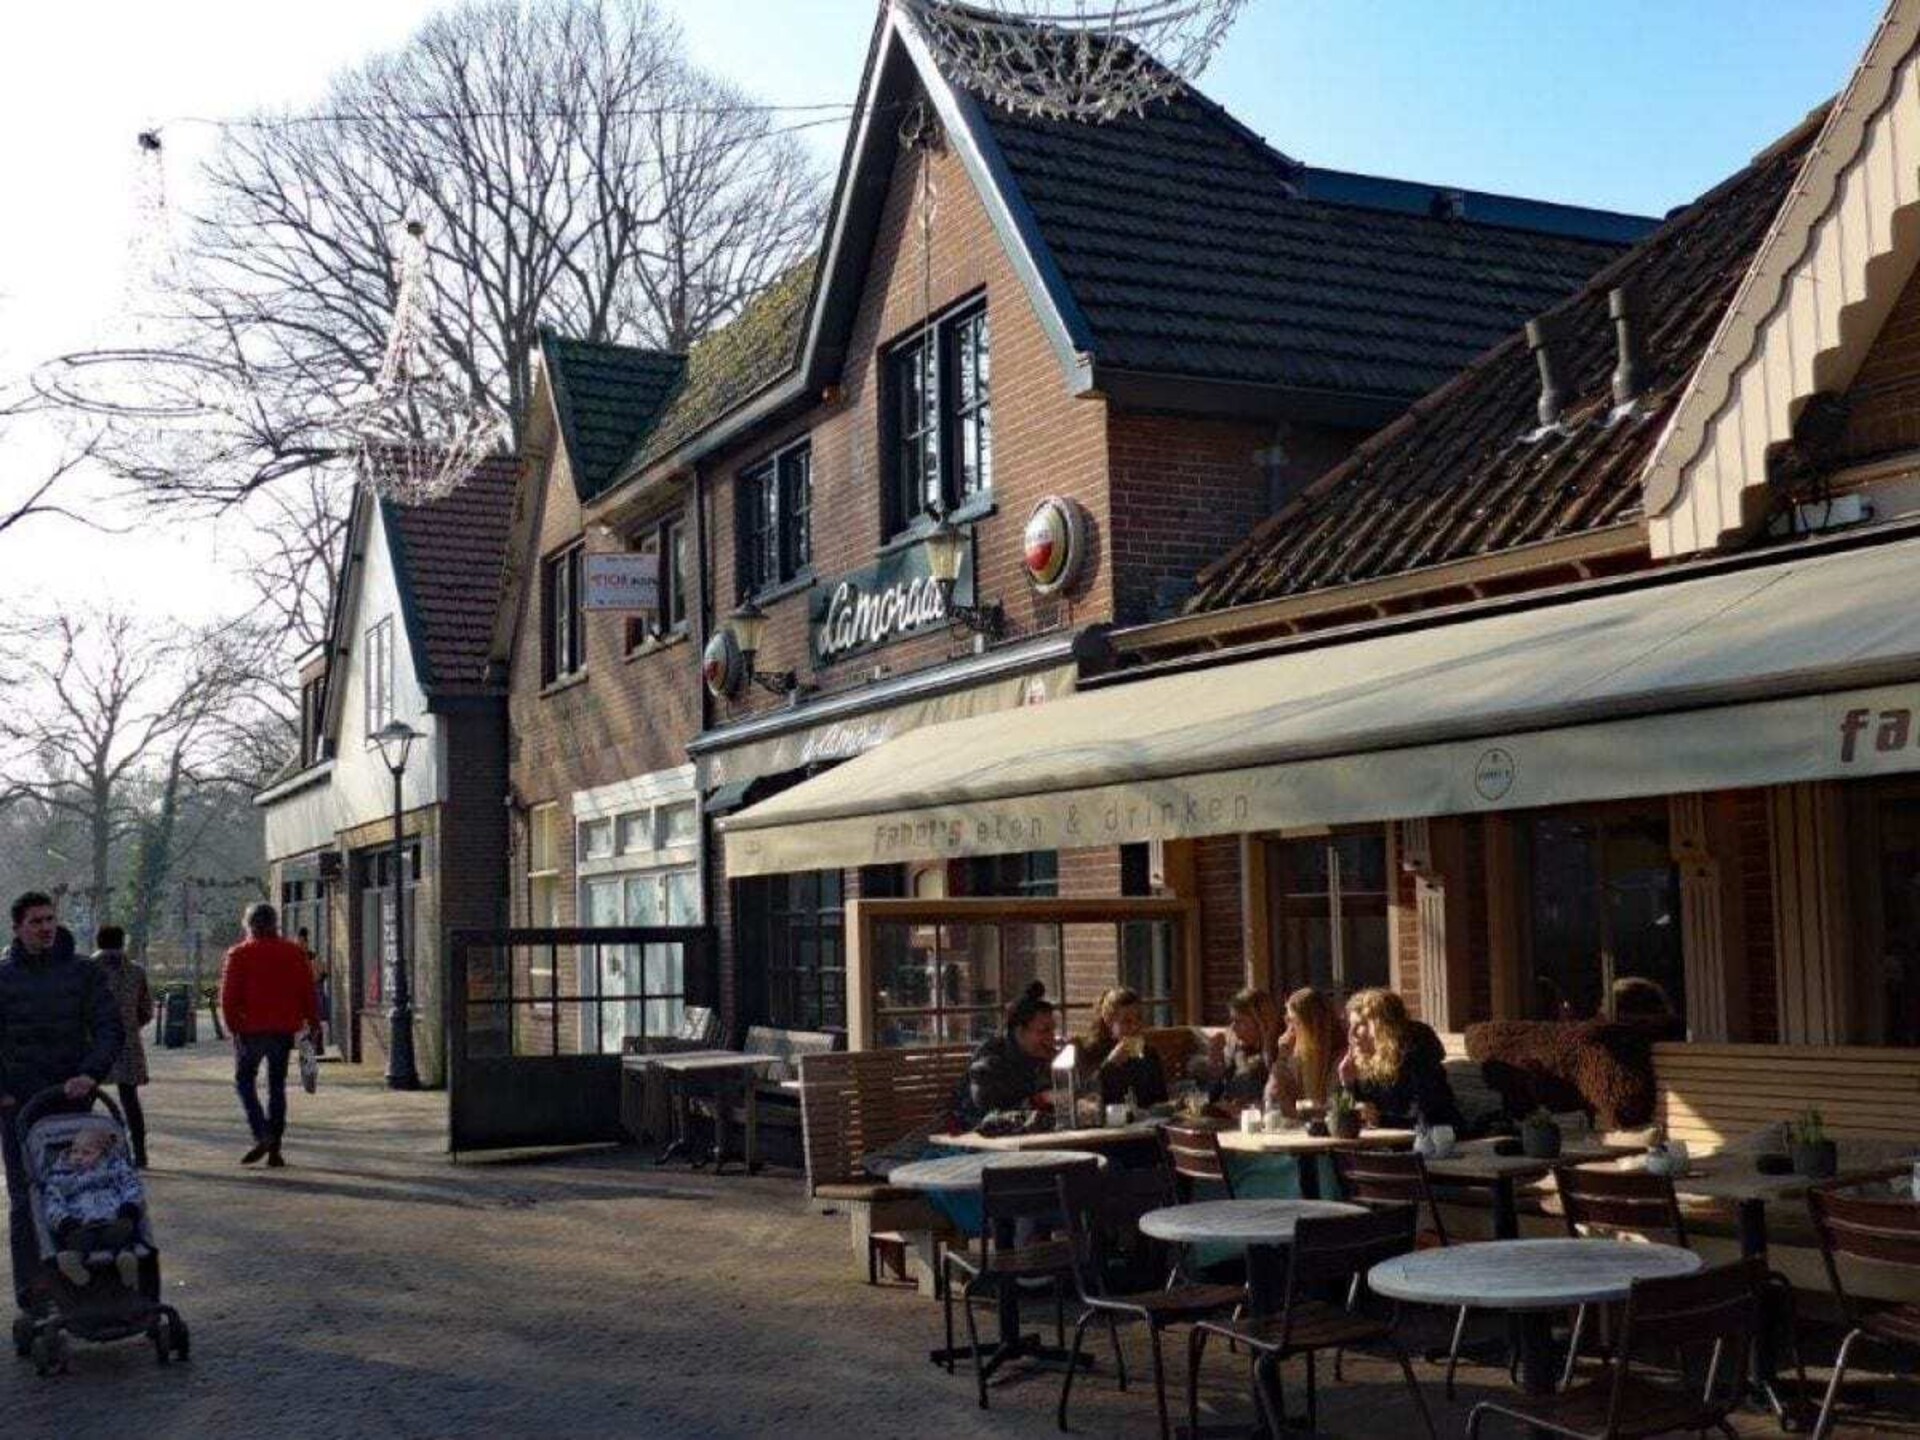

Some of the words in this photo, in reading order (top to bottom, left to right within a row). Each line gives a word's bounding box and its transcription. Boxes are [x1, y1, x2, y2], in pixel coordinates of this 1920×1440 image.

[818, 575, 947, 655] Lamoraa
[1840, 707, 1920, 763] fa
[1066, 802, 1081, 834] &
[1105, 793, 1248, 832] drinken
